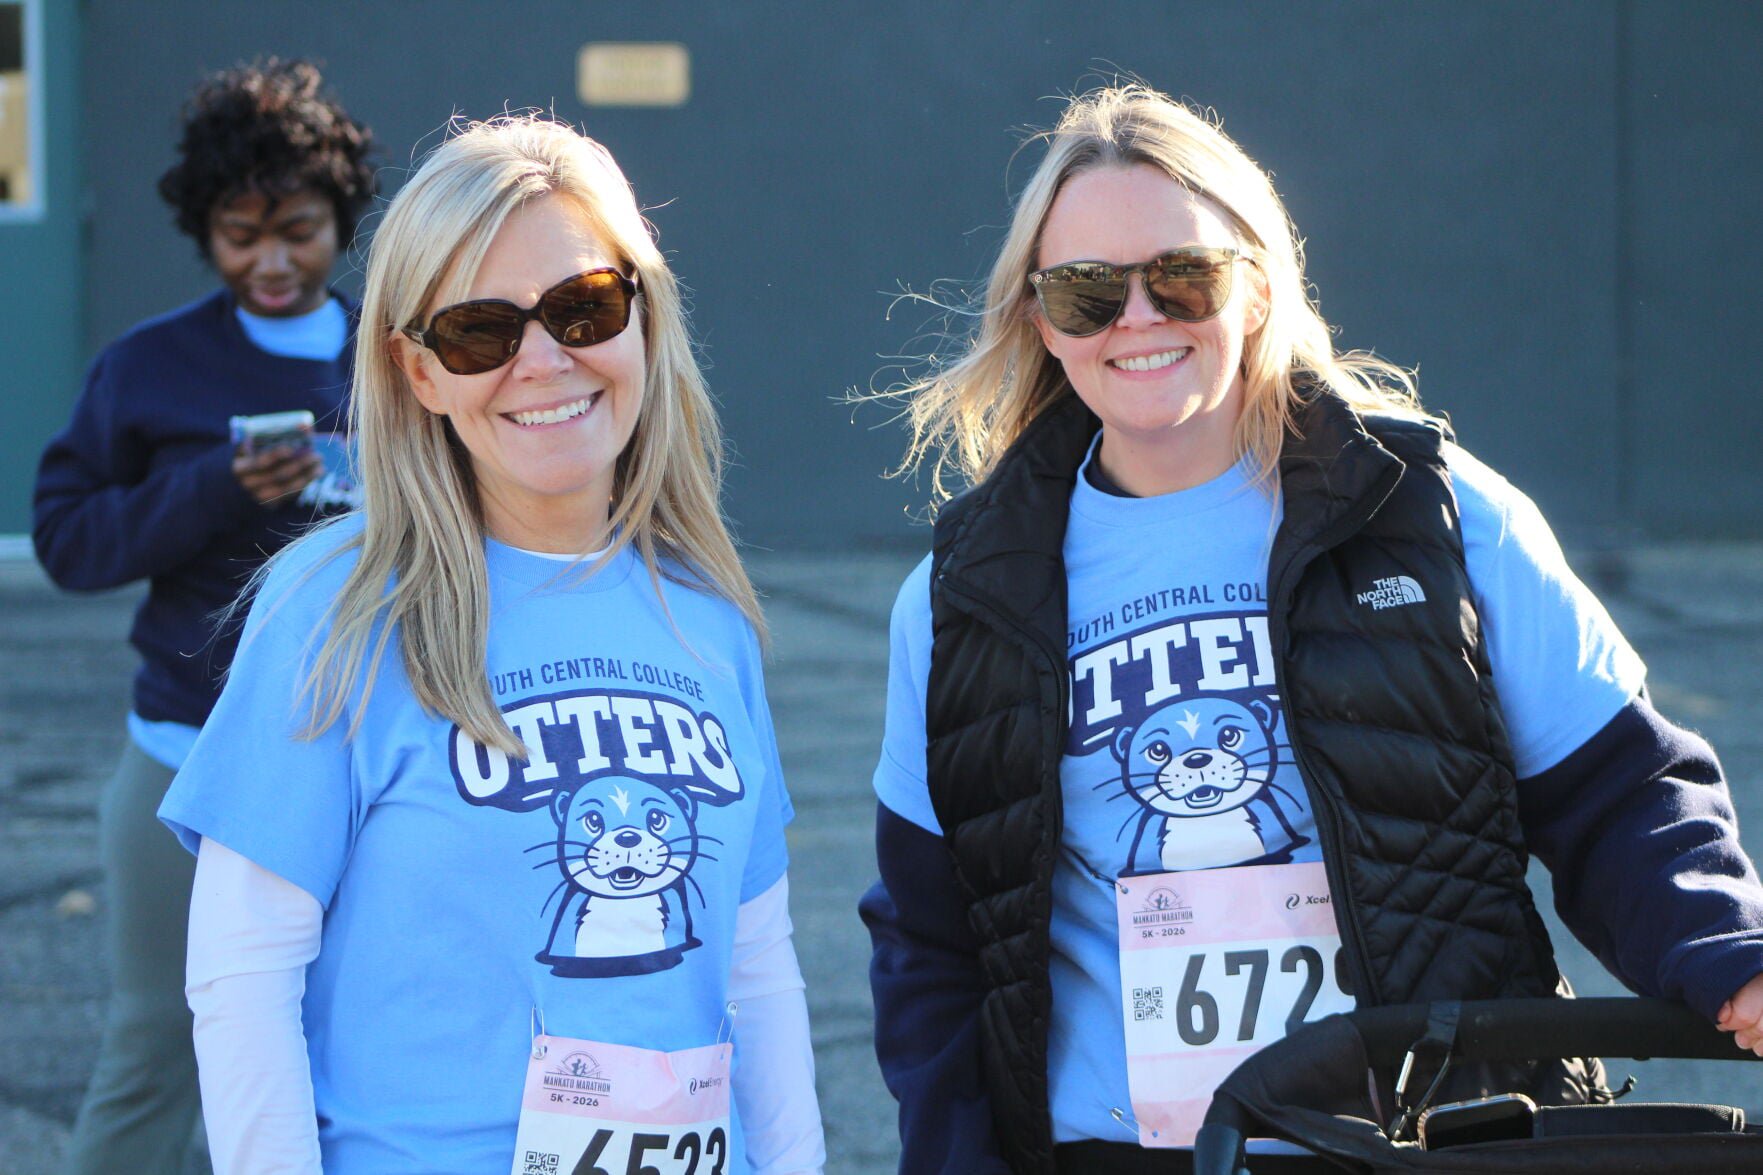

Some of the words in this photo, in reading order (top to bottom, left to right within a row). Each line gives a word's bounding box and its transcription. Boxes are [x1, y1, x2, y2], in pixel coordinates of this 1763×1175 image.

[1373, 577, 1398, 589] THE
[1121, 584, 1215, 624] CENTRAL
[1357, 586, 1401, 604] NORTH
[1372, 595, 1404, 610] FACE
[494, 668, 534, 695] UTH
[541, 657, 628, 684] CENTRAL
[632, 661, 705, 702] COLLEGE
[1068, 616, 1276, 728] TTE
[456, 695, 742, 798] OTTERS
[1133, 913, 1160, 925] MANKATO
[1161, 910, 1193, 922] MARATHON
[1142, 930, 1154, 938] 5K
[1161, 927, 1186, 937] 2026
[543, 1075, 575, 1089] MANKATO
[575, 1079, 611, 1093] MARATHON
[550, 1093, 565, 1103] 5K
[572, 1096, 599, 1107] 2026
